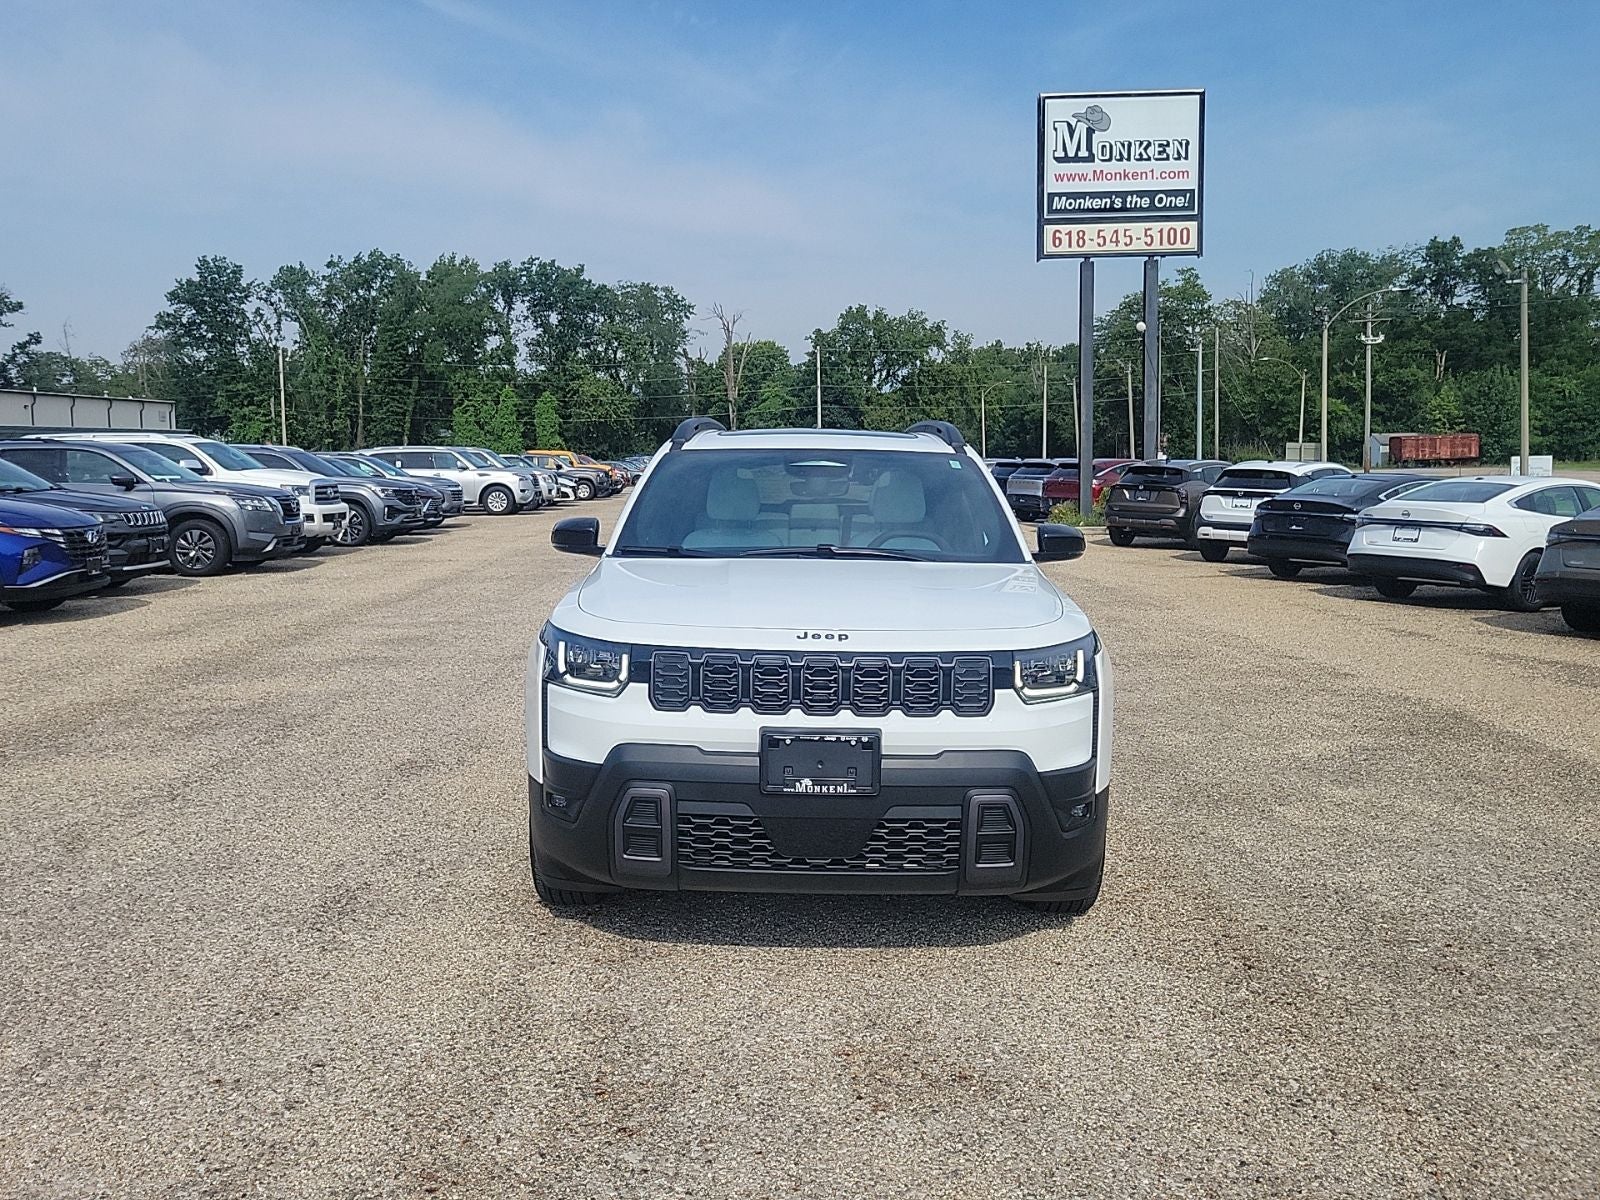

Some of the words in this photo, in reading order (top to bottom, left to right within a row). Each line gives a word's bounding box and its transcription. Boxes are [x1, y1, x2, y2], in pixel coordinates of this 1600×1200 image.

[1053, 120, 1190, 163] MONKEN
[1054, 168, 1190, 182] www.Monken1.com
[1052, 195, 1123, 210] Monken's
[1126, 194, 1150, 208] the
[1154, 193, 1191, 208] One!
[1051, 227, 1191, 249] 618-545-5100
[796, 631, 849, 642] Jeep
